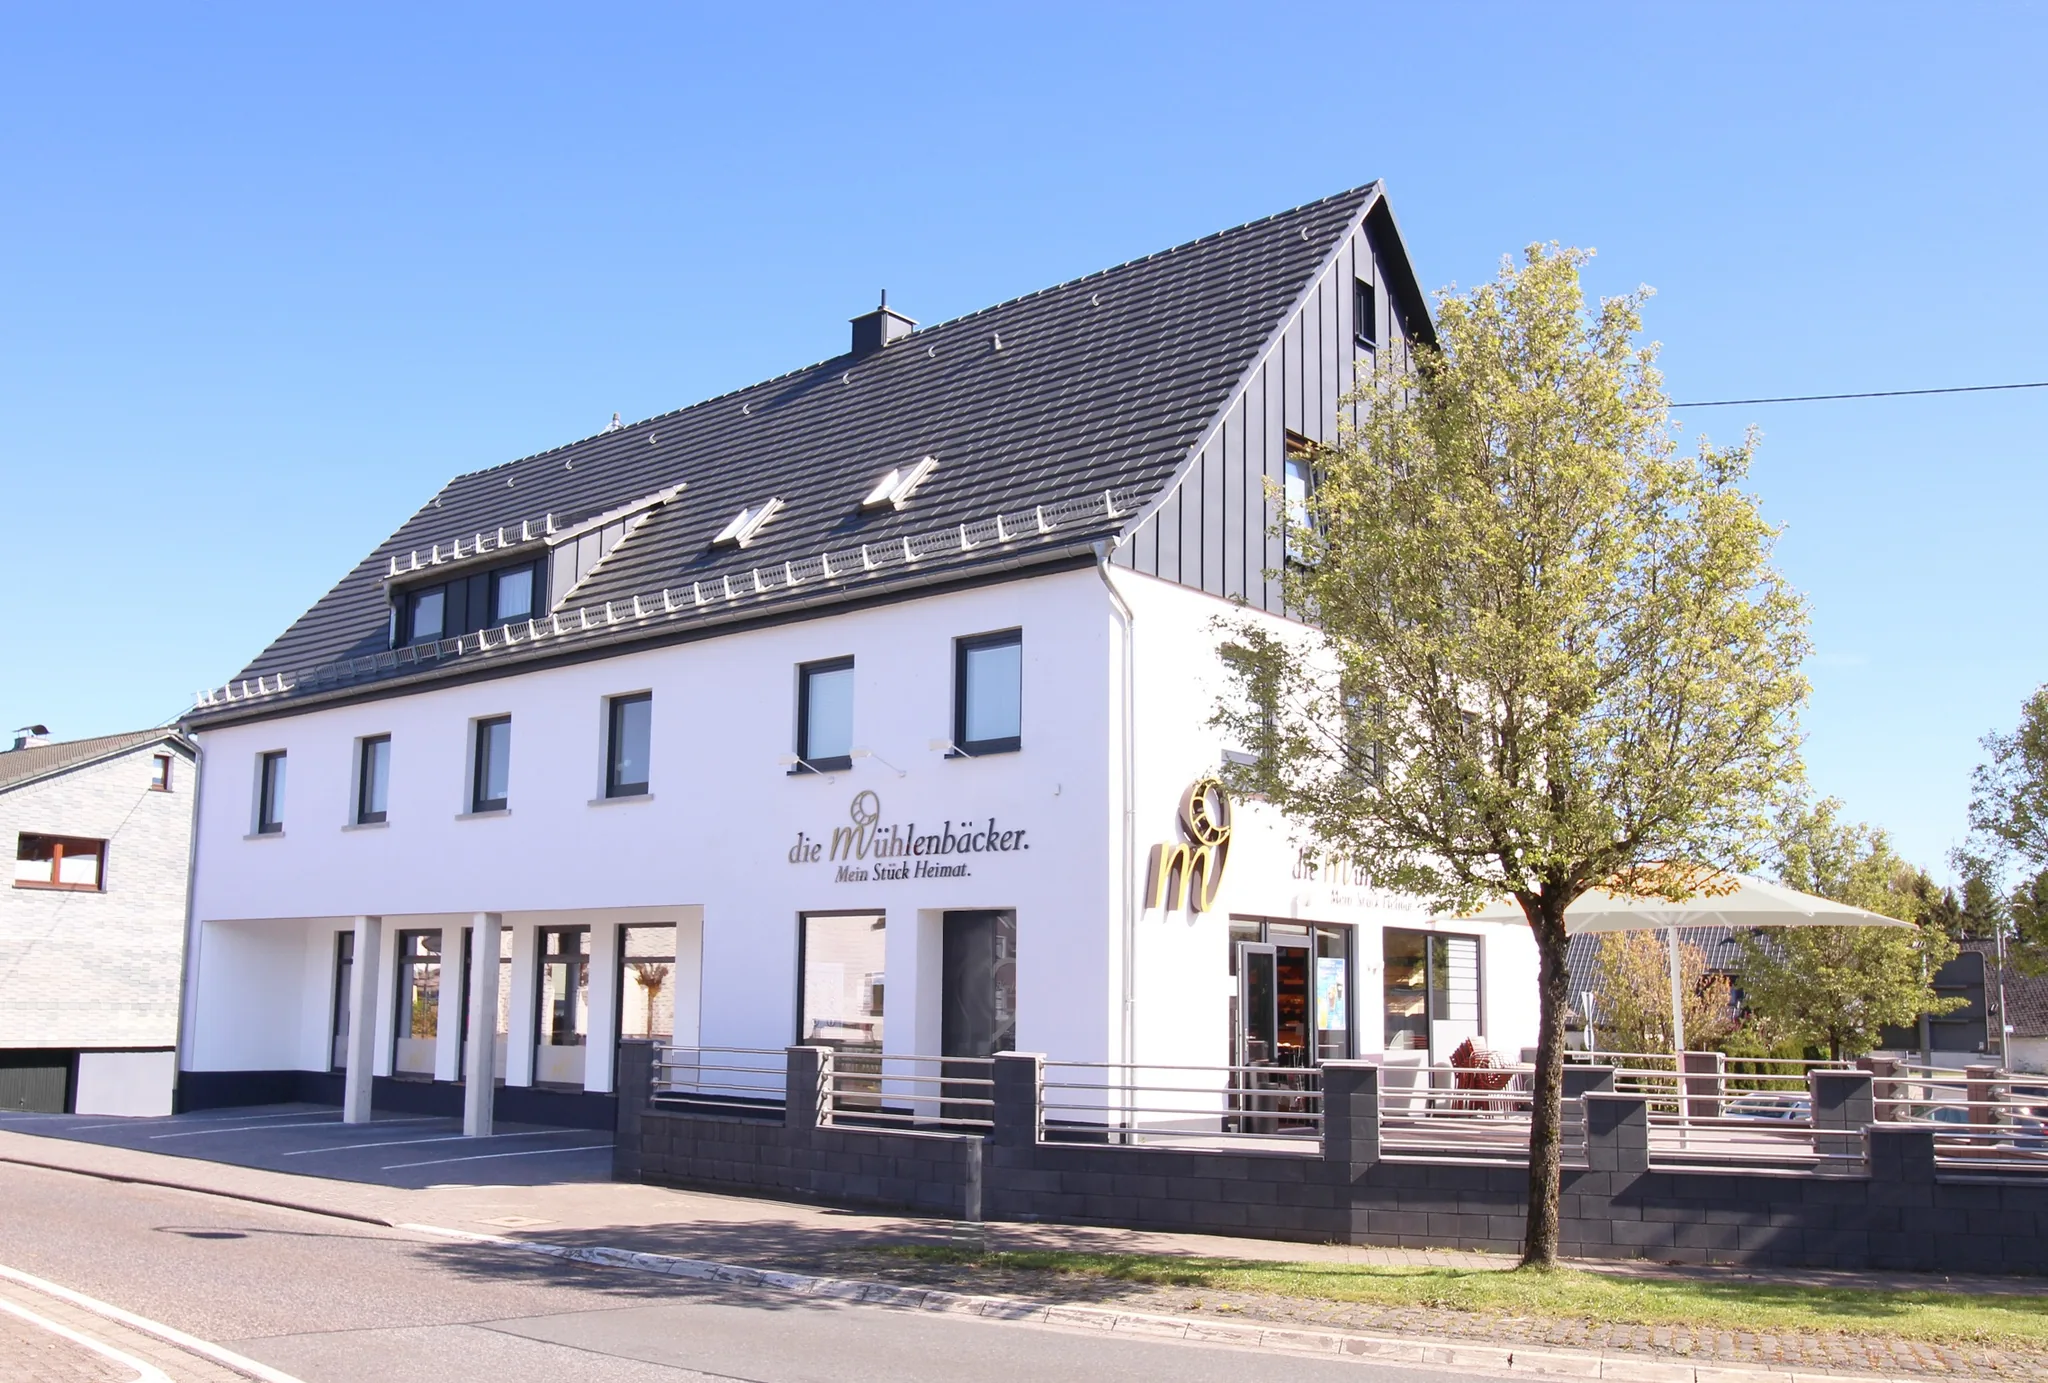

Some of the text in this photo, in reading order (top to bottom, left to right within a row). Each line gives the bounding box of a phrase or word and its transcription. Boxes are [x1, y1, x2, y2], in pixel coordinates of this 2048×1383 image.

[788, 832, 822, 863] die
[834, 859, 972, 883] Mein Stück Heimat.
